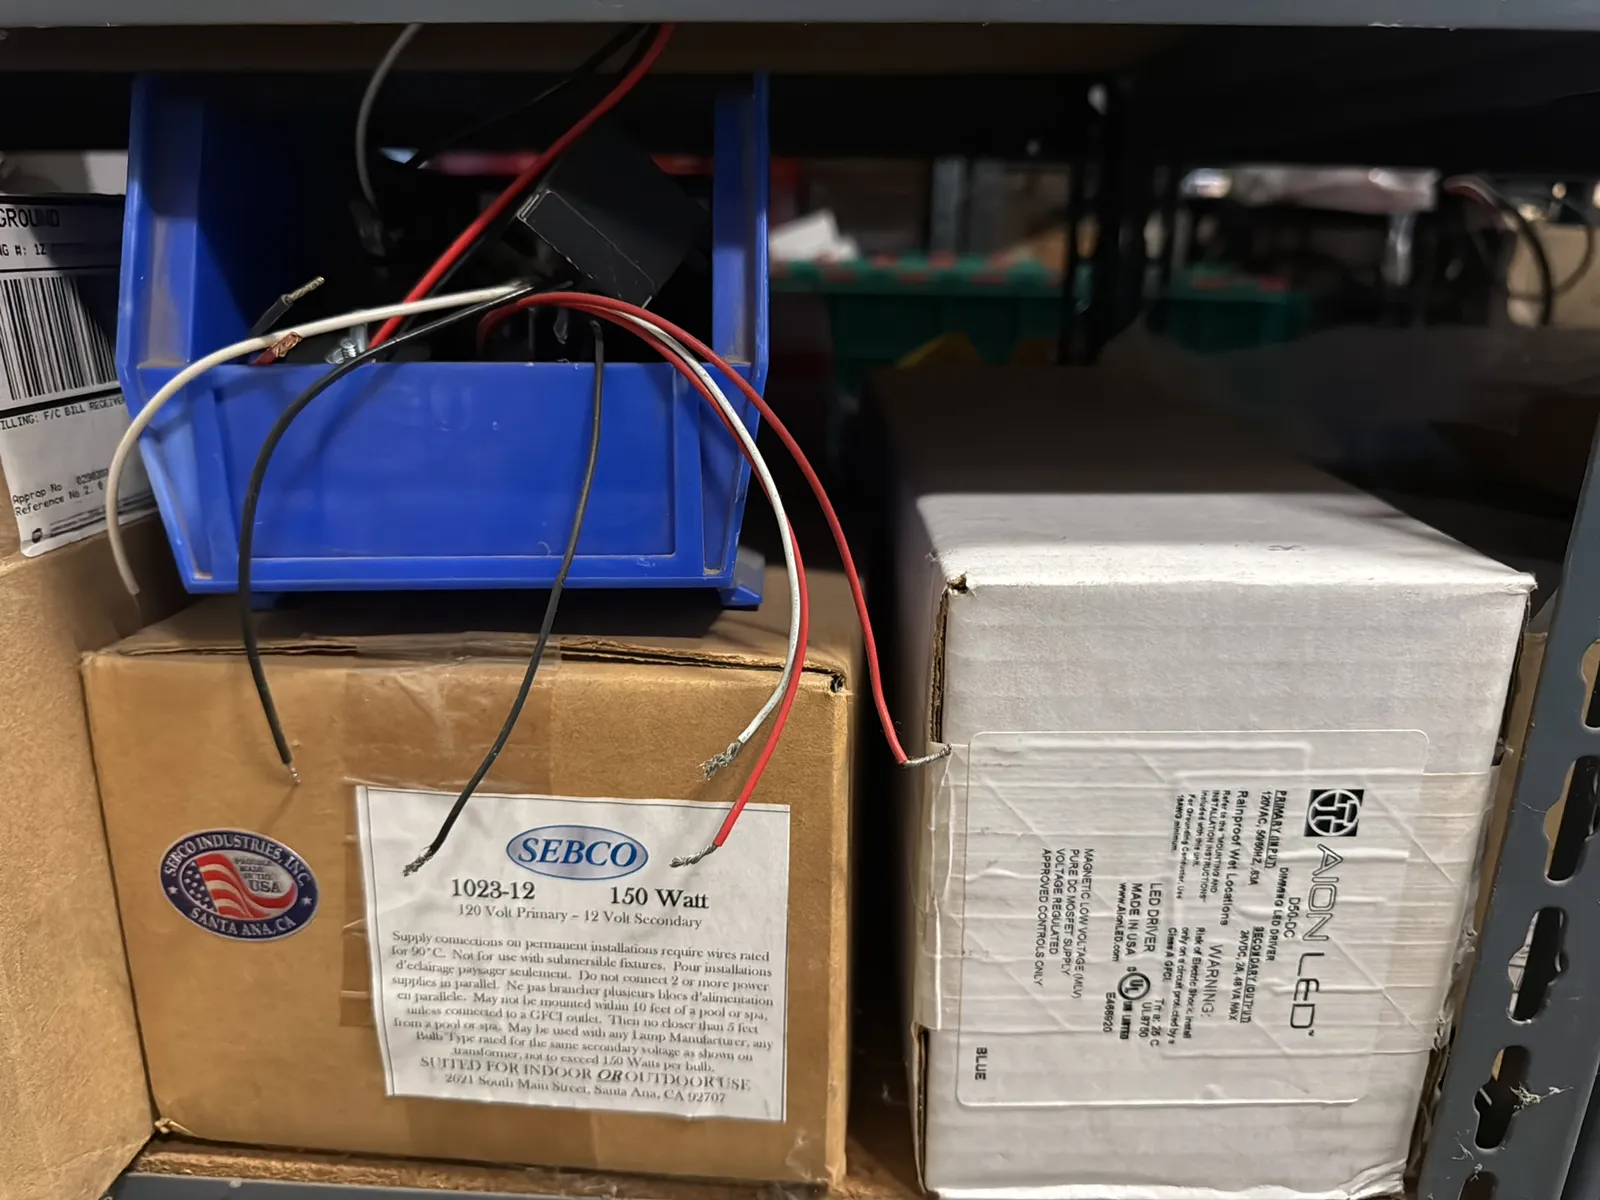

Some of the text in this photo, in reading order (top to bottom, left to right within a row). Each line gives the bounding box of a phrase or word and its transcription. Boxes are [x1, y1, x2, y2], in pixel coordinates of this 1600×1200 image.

[15, 495, 65, 516] Reference
[1206, 789, 1221, 843] INSTALLATION
[1270, 790, 1288, 834] PRIMARY
[518, 837, 638, 868] SEBCO
[1219, 790, 1249, 926] Rainproof Wet Locations
[250, 879, 283, 893] USA
[452, 878, 536, 900] 1023-12
[611, 886, 710, 909] 150 Watt
[1049, 848, 1066, 955] VOLTAGE REGULATED
[1209, 878, 1220, 894] AND
[1302, 843, 1344, 941] AION
[190, 907, 238, 935] SANTA
[275, 915, 297, 931] CA
[459, 903, 703, 930] 120 Volt Primary 12 Volt Secondary
[1033, 848, 1051, 986] APPROVED CONTROLS ONLY
[1060, 848, 1081, 976] PURE DC MOSFET SUPPLY
[1071, 848, 1094, 999] MAGNETIC LOW VOLTAGE (MLV)
[1124, 882, 1143, 957] MADE IN USA
[1143, 882, 1162, 953] LED DRIVER
[1271, 909, 1283, 926] LED
[1283, 897, 1302, 938] D50-DC
[392, 930, 770, 962] Supply connections on permanent installations require wires rated
[1246, 926, 1265, 982] SECONDARY
[1265, 929, 1280, 962] DRIVER
[391, 946, 408, 956] for
[452, 948, 475, 961] Not
[477, 949, 494, 962] for
[498, 953, 517, 963] use
[520, 951, 544, 964] with
[547, 953, 617, 968] submersible
[673, 961, 703, 973] Pour
[704, 962, 773, 978] installations
[392, 974, 437, 989] supplies
[440, 978, 452, 988] in
[506, 979, 524, 991] Ne
[527, 984, 546, 996] pas
[549, 982, 601, 996] brancher
[603, 985, 655, 999] plusieurs
[658, 988, 689, 1001] blocs
[690, 990, 774, 1007] d'alimentation
[458, 966, 506, 977] paysager
[509, 967, 572, 980] seulement.
[578, 970, 598, 981] Do
[601, 971, 619, 982] not
[623, 973, 668, 985] connect
[670, 974, 679, 986] 2
[682, 977, 696, 987] or
[698, 978, 729, 989] more
[732, 981, 770, 993] power
[407, 1006, 442, 1017] unless
[445, 1008, 503, 1019] connected
[506, 1009, 517, 1019] to
[530, 1010, 563, 1022] GFCI
[608, 1014, 640, 1027] Then
[644, 1019, 659, 1029] no
[661, 1018, 697, 1031] closer
[699, 1020, 724, 1032] than
[727, 1022, 735, 1032] 5
[738, 1022, 759, 1034] feet
[1227, 1001, 1240, 1021] MAX
[420, 1056, 751, 1092] SUITED FOR INDOOR OR OUTDOOR USE
[524, 1051, 543, 1062] not
[546, 1052, 558, 1062] to
[560, 1054, 599, 1066] exceed
[602, 1055, 624, 1066] 150
[627, 1056, 661, 1069] Watts
[663, 1060, 682, 1072] per
[975, 1047, 988, 1080] BLUE
[478, 1075, 514, 1089] South
[517, 1078, 549, 1091] Main
[552, 1080, 591, 1095] Street,
[594, 1085, 627, 1097] Santa
[630, 1086, 661, 1099] Ana,
[663, 1089, 684, 1101] CA
[687, 1091, 726, 1104] 92707
